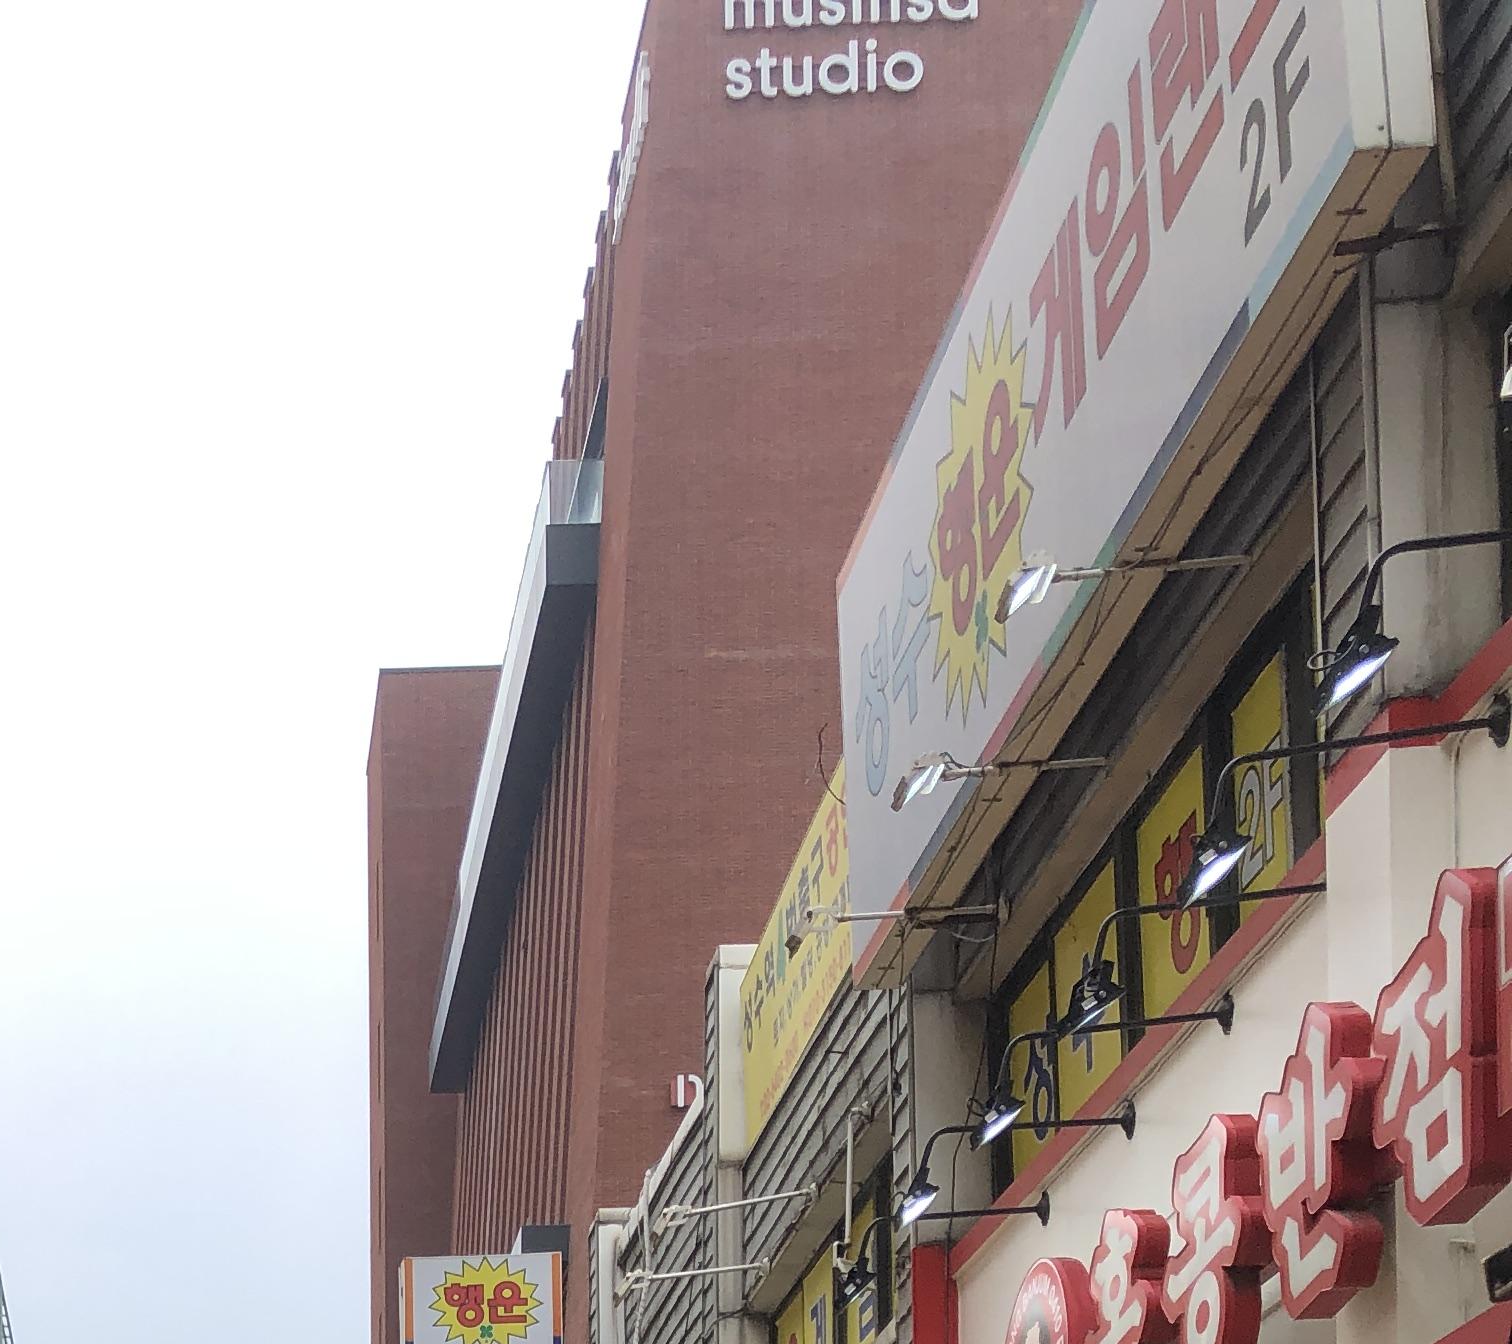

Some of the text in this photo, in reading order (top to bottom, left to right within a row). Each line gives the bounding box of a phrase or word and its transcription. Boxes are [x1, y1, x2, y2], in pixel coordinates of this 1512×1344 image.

[726, 38, 924, 99] studio
[1240, 5, 1310, 248] 2F
[1029, 0, 1280, 448] 게임랜
[937, 379, 1023, 637] 행운
[855, 550, 931, 797] 성수
[1238, 738, 1288, 892] 2F
[743, 940, 776, 1053] 성수역
[444, 1281, 529, 1326] 행운
